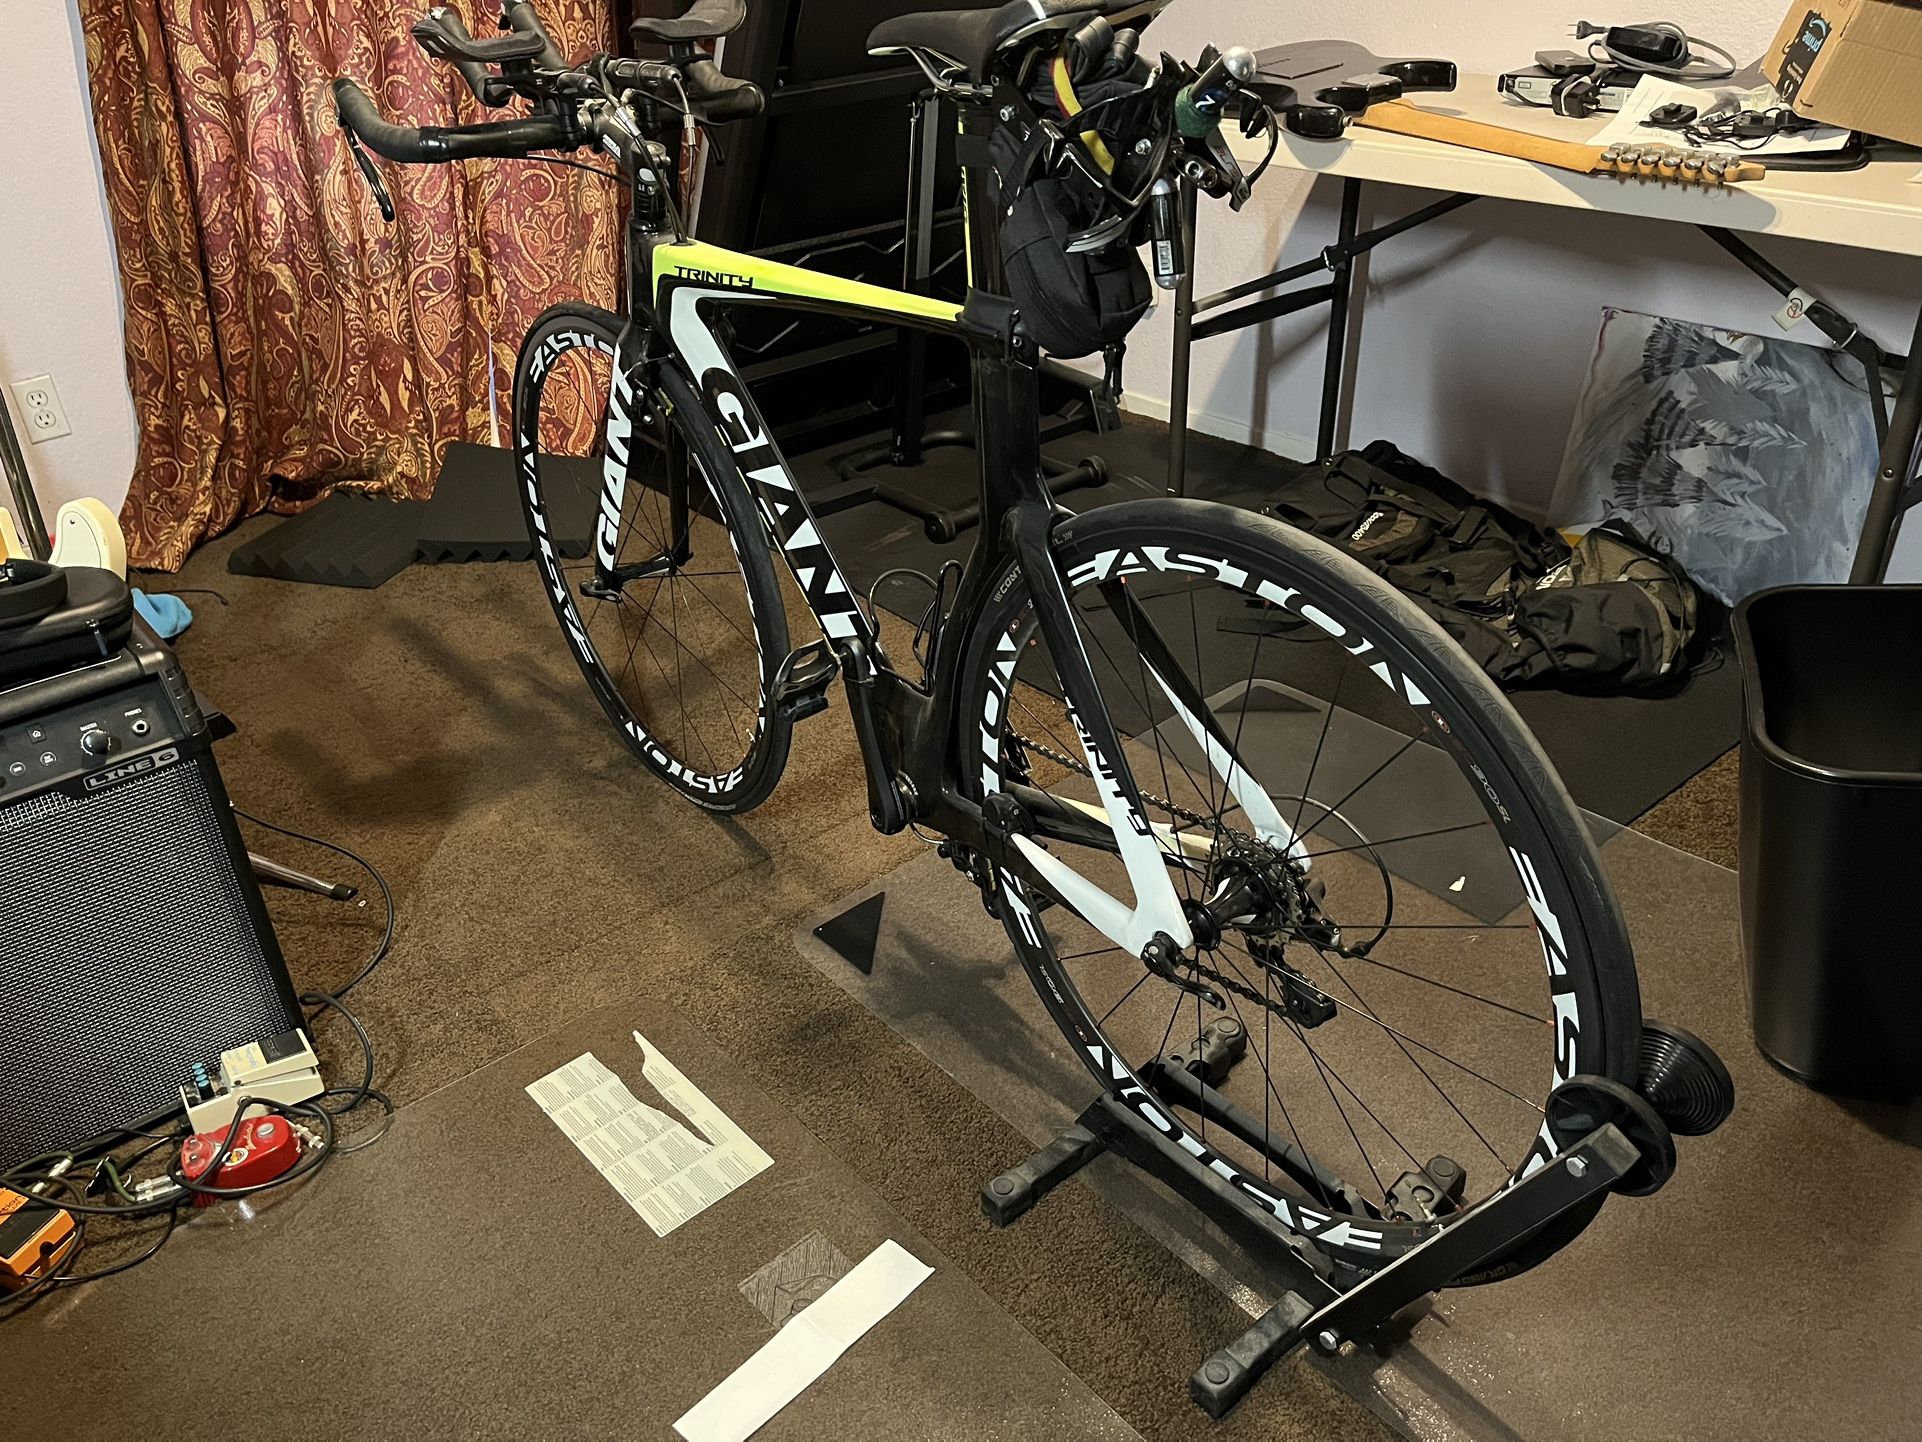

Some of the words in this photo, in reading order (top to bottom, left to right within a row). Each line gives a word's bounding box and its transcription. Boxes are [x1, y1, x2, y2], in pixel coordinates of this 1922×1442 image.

[529, 329, 615, 384] EASTO
[673, 265, 754, 288] TRINITY
[597, 342, 634, 573] GIANT
[700, 366, 880, 678] GIANT
[519, 431, 596, 665] EASTON
[1066, 545, 1432, 706] EASTON
[89, 757, 152, 788] LINE
[158, 751, 175, 762] 6
[623, 720, 744, 794] EASTON
[1085, 1044, 1384, 1252] EASTON
